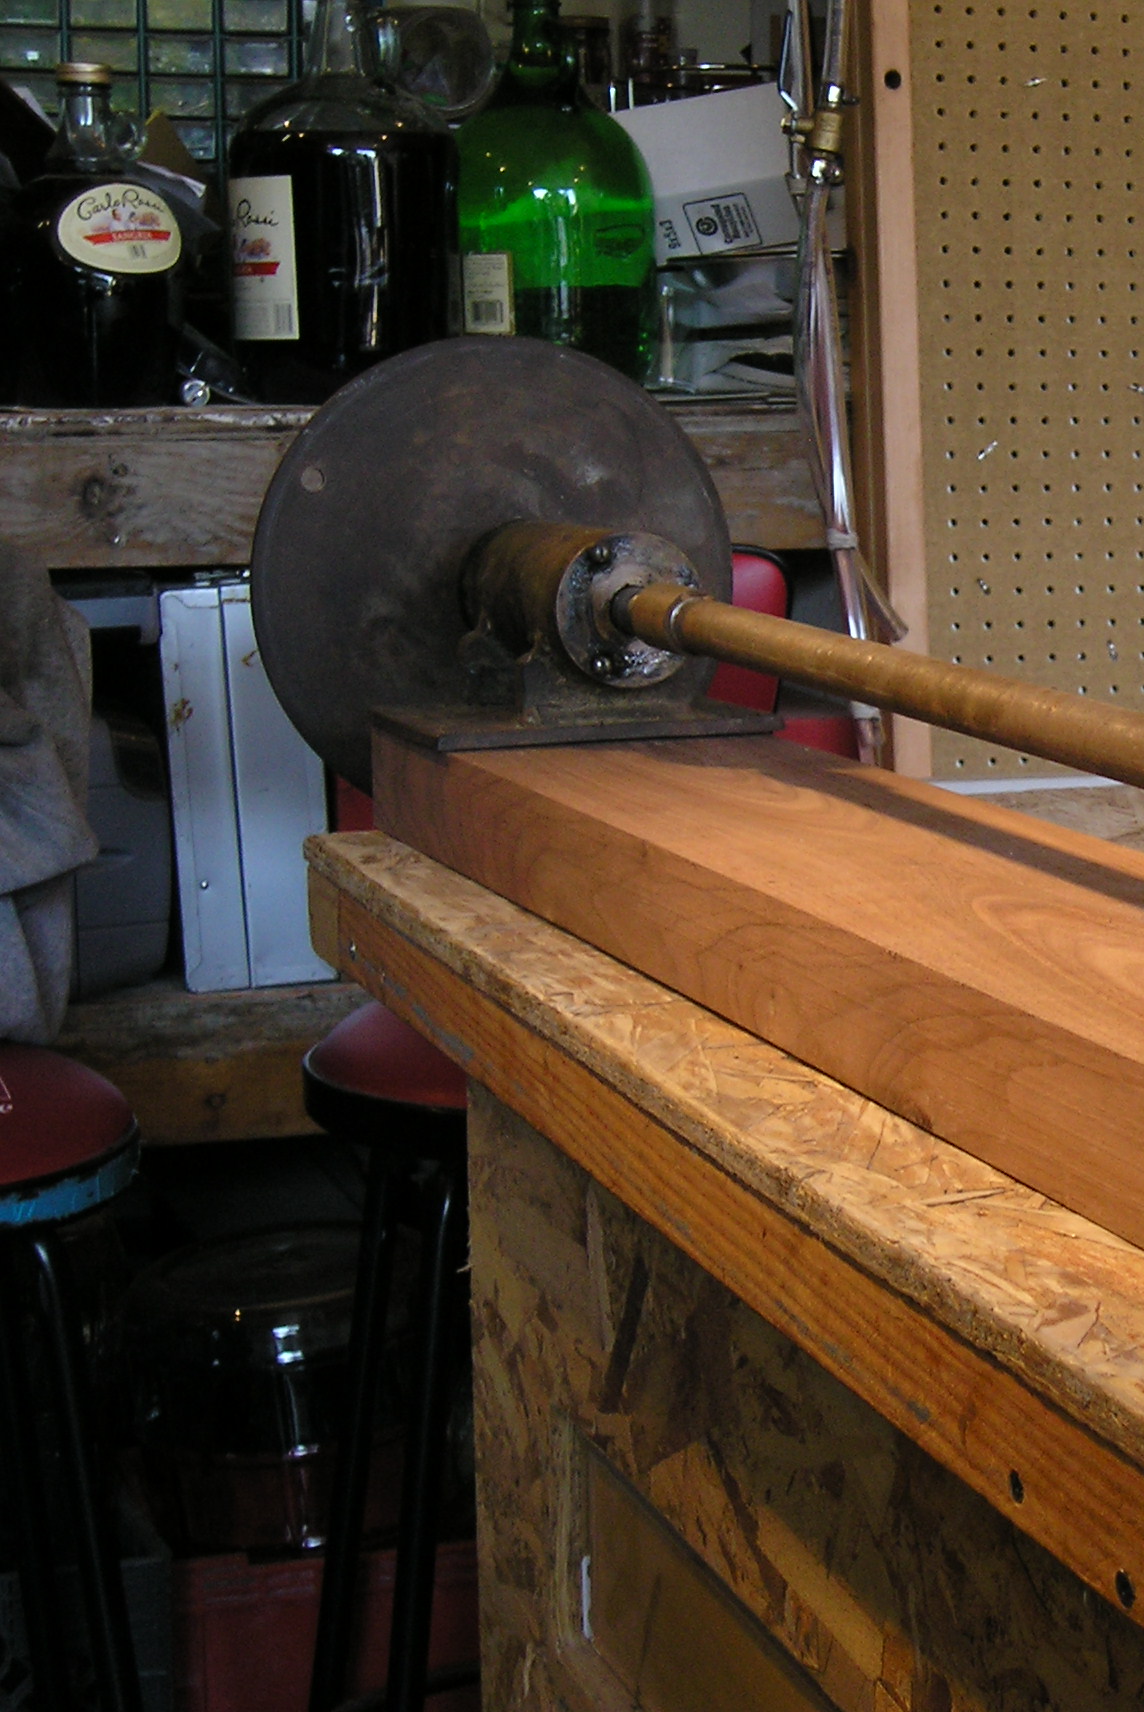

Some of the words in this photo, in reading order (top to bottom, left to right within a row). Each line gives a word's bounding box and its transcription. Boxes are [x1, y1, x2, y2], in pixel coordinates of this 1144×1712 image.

[76, 192, 121, 220] Carlo
[121, 189, 164, 213] Rossi
[236, 199, 279, 228] Rossi
